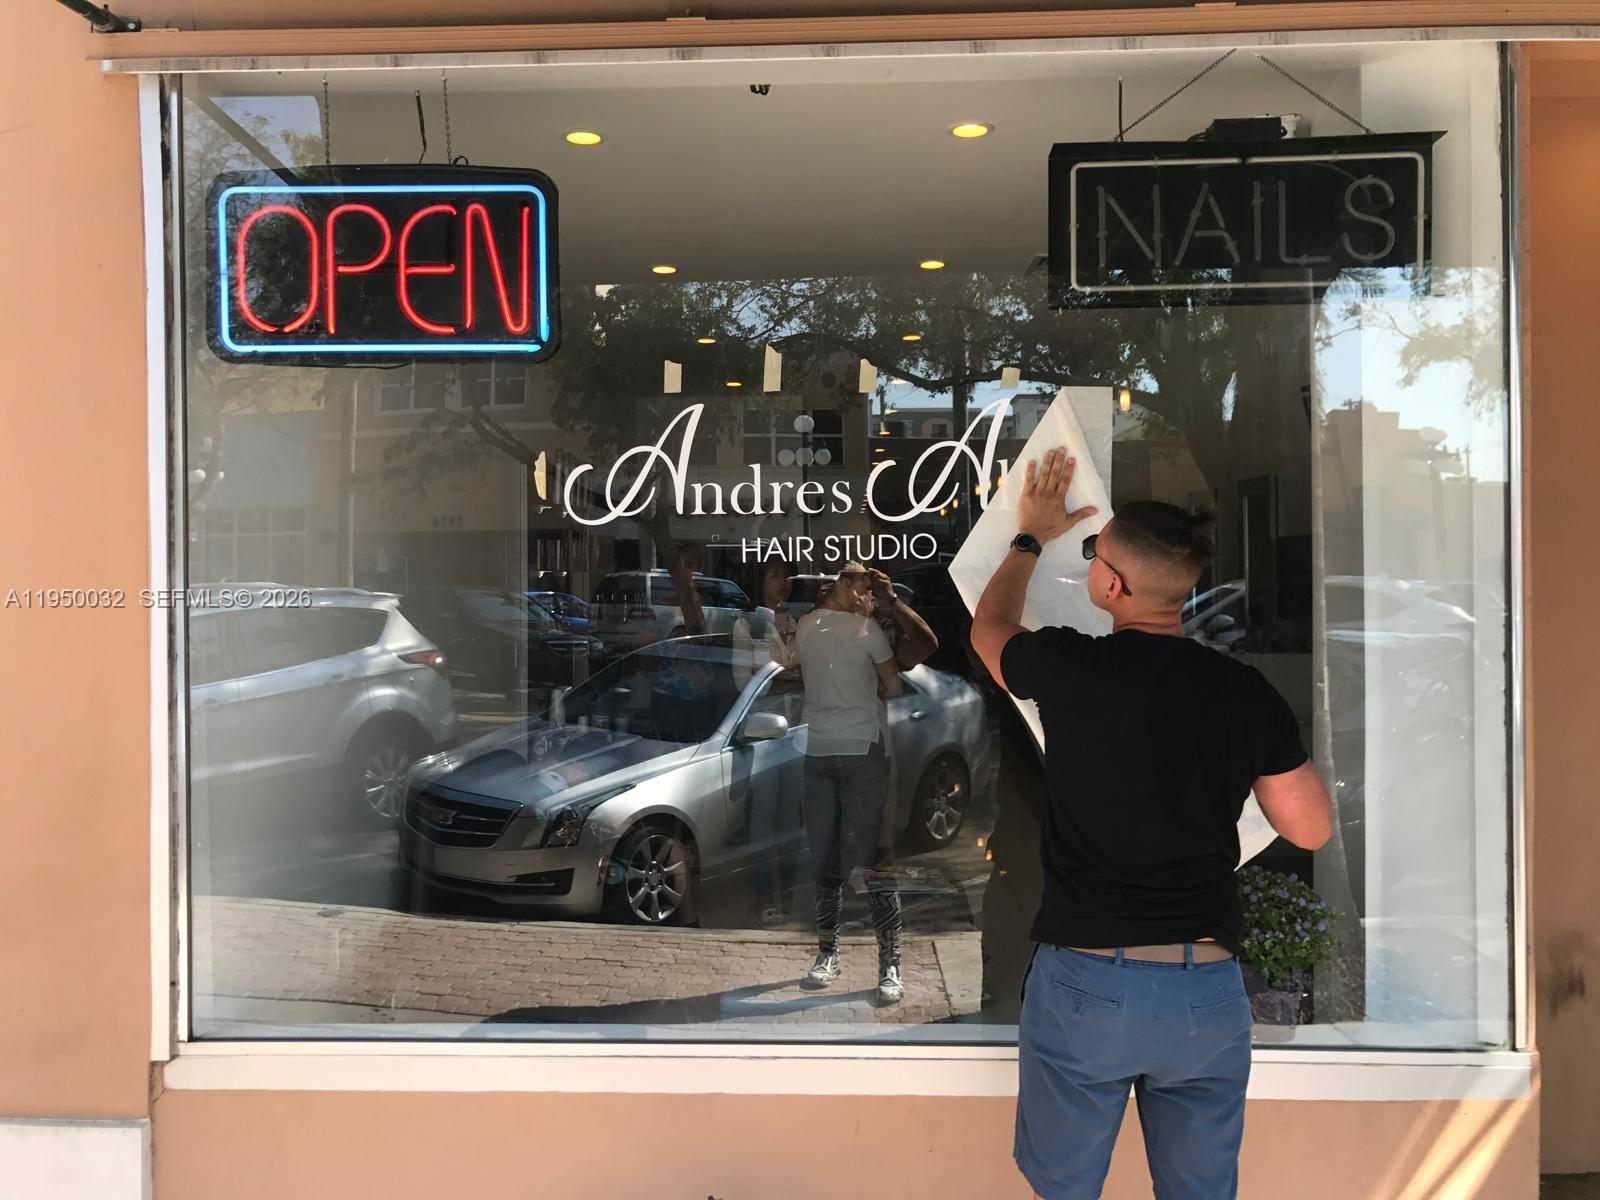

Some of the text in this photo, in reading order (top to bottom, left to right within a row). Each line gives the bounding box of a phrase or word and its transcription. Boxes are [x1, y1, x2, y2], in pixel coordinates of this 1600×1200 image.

[236, 203, 531, 335] OPEN
[1096, 175, 1396, 269] NAILS
[564, 403, 853, 526] Andres
[741, 532, 937, 563] HAIR STUDIO
